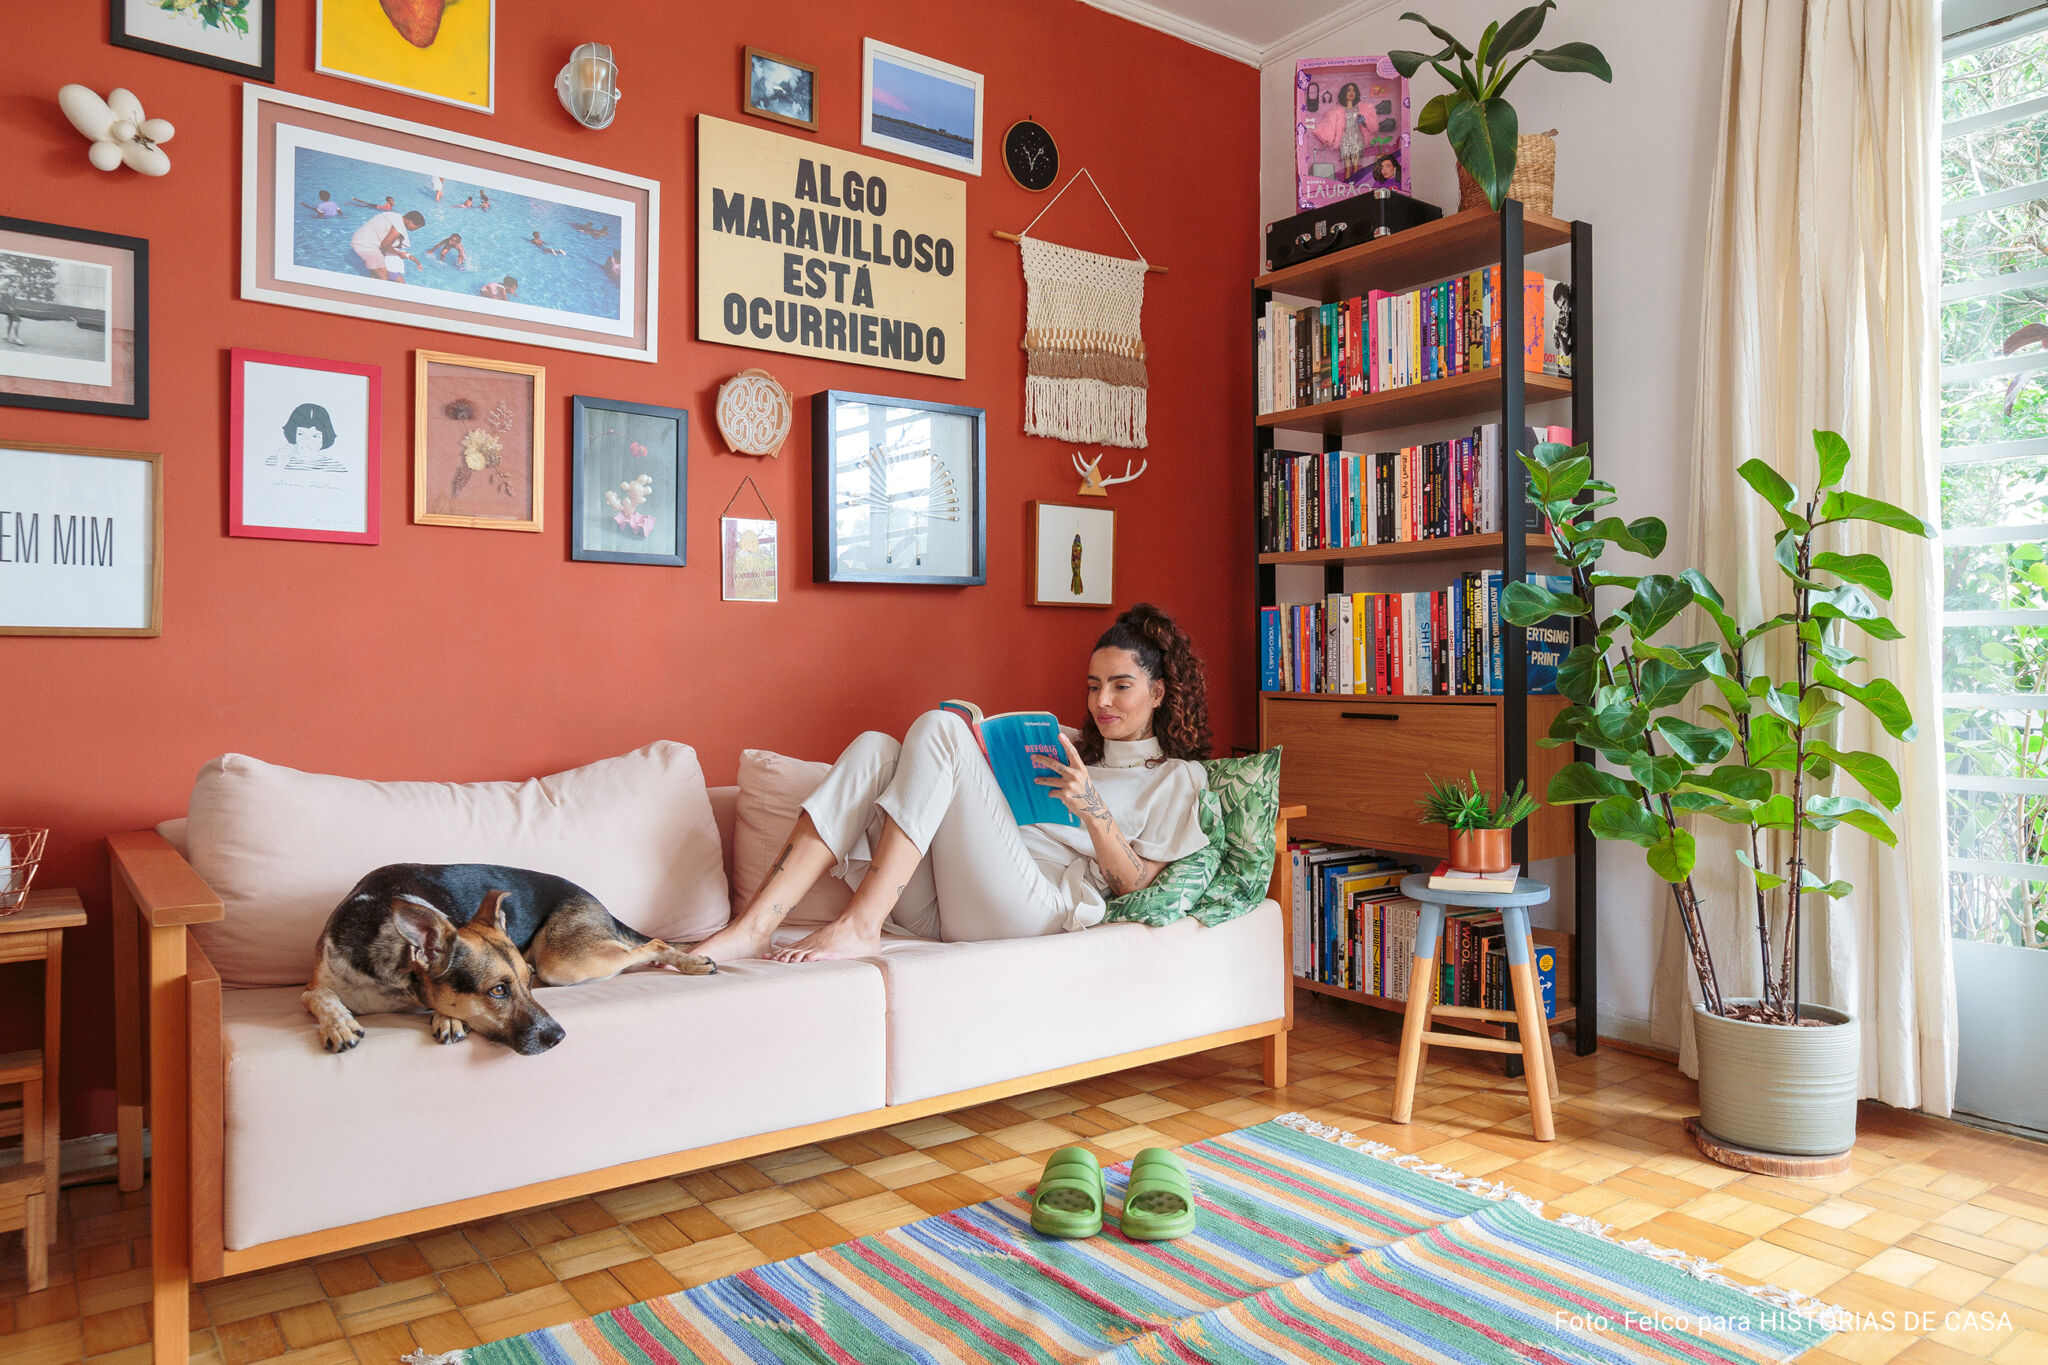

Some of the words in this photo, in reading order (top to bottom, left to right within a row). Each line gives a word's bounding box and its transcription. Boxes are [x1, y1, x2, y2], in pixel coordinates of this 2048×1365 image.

[795, 158, 887, 217] ALGO
[1306, 181, 1372, 199] LAURÃO
[713, 187, 955, 277] MARAVILLOSO
[783, 254, 874, 309] ESTÁ
[723, 292, 946, 366] OCURRIENDO
[1544, 353, 1556, 363] 001
[0, 511, 38, 563] EM
[54, 514, 113, 567] MIM
[1474, 588, 1482, 628] WATCHMEN
[1490, 587, 1500, 636] ADVERTISING
[1420, 622, 1430, 662] SHIFT
[1526, 627, 1569, 645] ERTISING
[1494, 658, 1502, 680] PRINT
[1531, 650, 1560, 667] PRINT
[1462, 926, 1471, 964] WOOL
